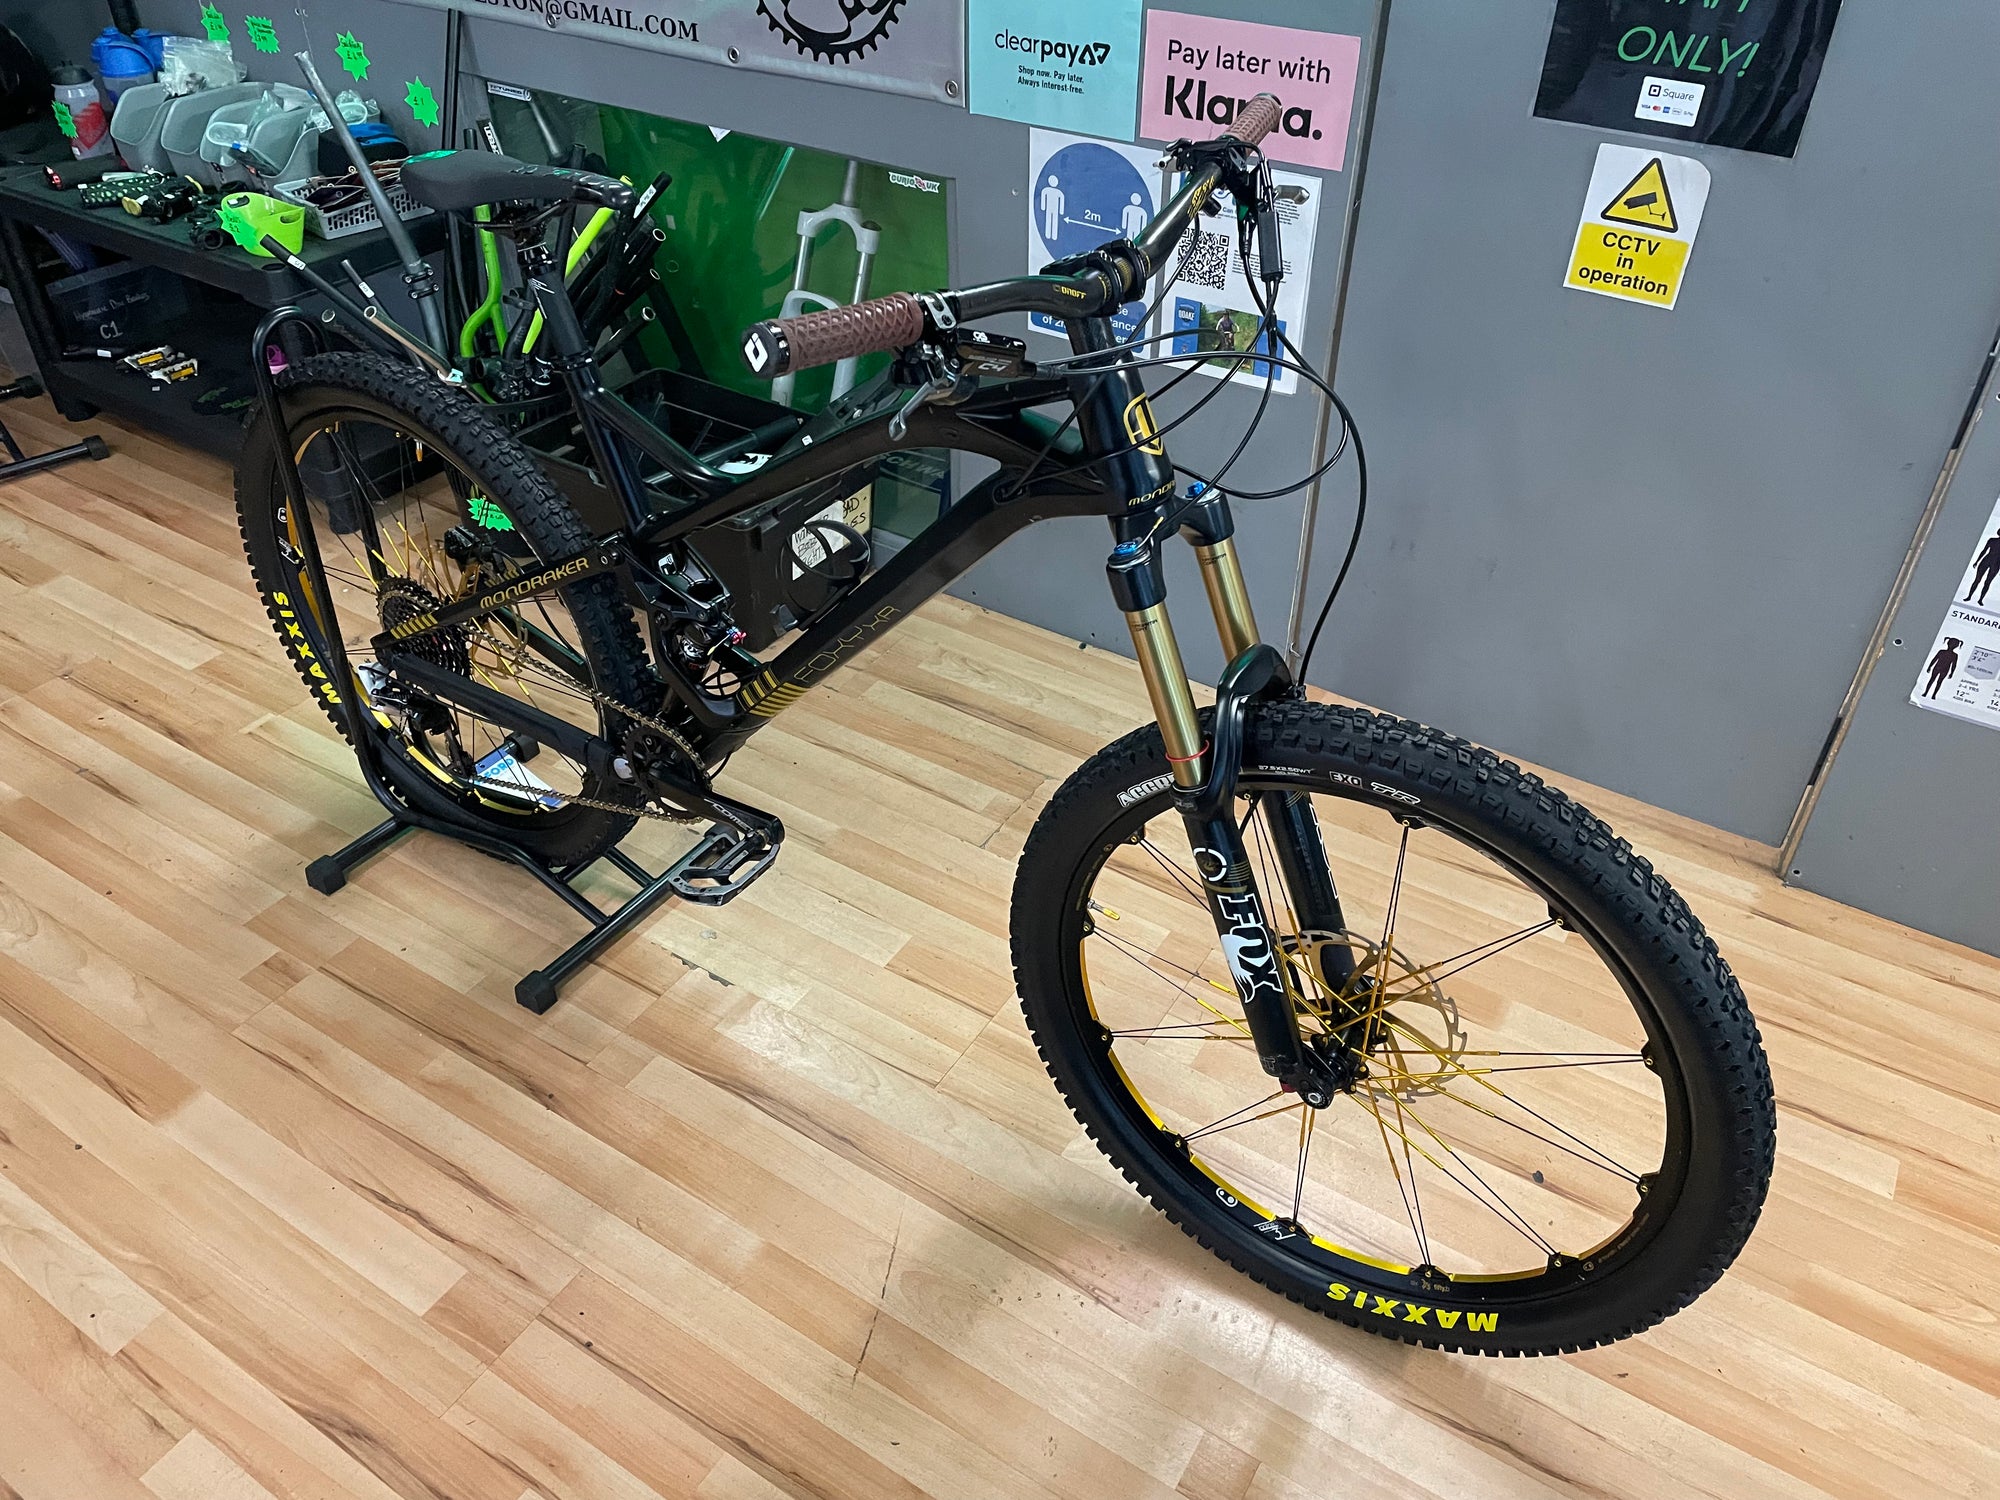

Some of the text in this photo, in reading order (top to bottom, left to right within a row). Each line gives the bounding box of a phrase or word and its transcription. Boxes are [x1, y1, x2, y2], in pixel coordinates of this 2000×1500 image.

[995, 28, 1079, 67] clearpay
[1168, 39, 1331, 84] Pay later with
[1618, 26, 1760, 77] ONLY!
[1017, 76, 1039, 87] Always
[1018, 65, 1034, 75] Shop
[1053, 70, 1065, 81] Pay
[1067, 73, 1084, 83] later.
[1164, 75, 1322, 140] Klaa.
[1662, 88, 1694, 101] Square
[1084, 209, 1101, 223] 2m
[1603, 232, 1661, 256] CCTV
[1616, 253, 1634, 270] in
[1579, 267, 1668, 296] operation
[99, 320, 123, 339] C1
[480, 557, 589, 609] MONDRAKER
[272, 591, 343, 704] MAXXIS
[794, 625, 864, 683] FOXY
[1329, 771, 1421, 805] EXO TR
[1217, 893, 1284, 1003] FOX
[1326, 1282, 1499, 1333] MAXXIS
